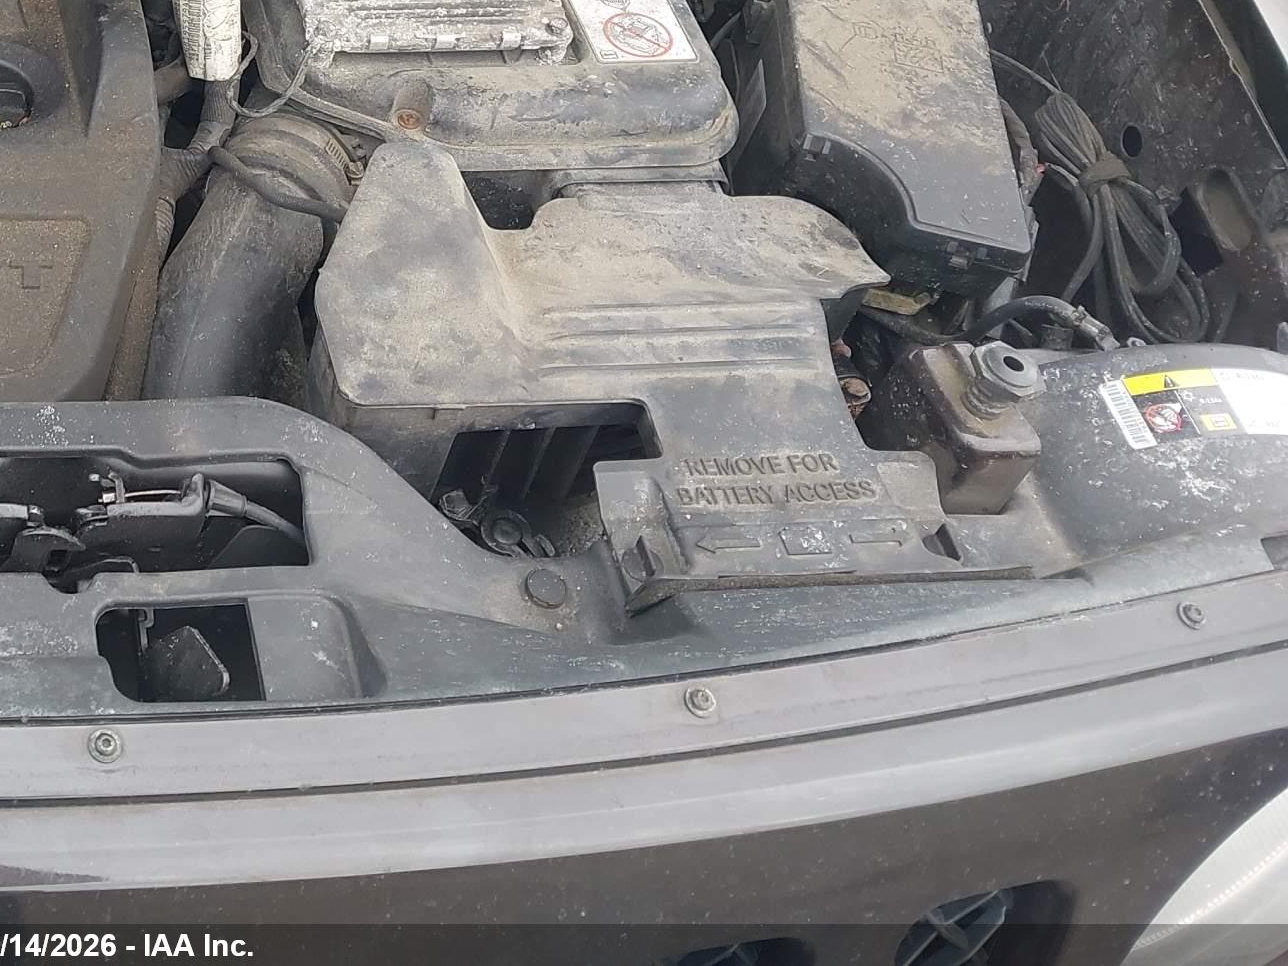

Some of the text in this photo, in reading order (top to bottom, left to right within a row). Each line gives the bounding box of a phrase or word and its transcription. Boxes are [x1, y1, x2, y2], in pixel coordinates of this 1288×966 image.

[684, 452, 840, 477] REMOVE FOR
[677, 480, 877, 506] BATTERY ACCESS
